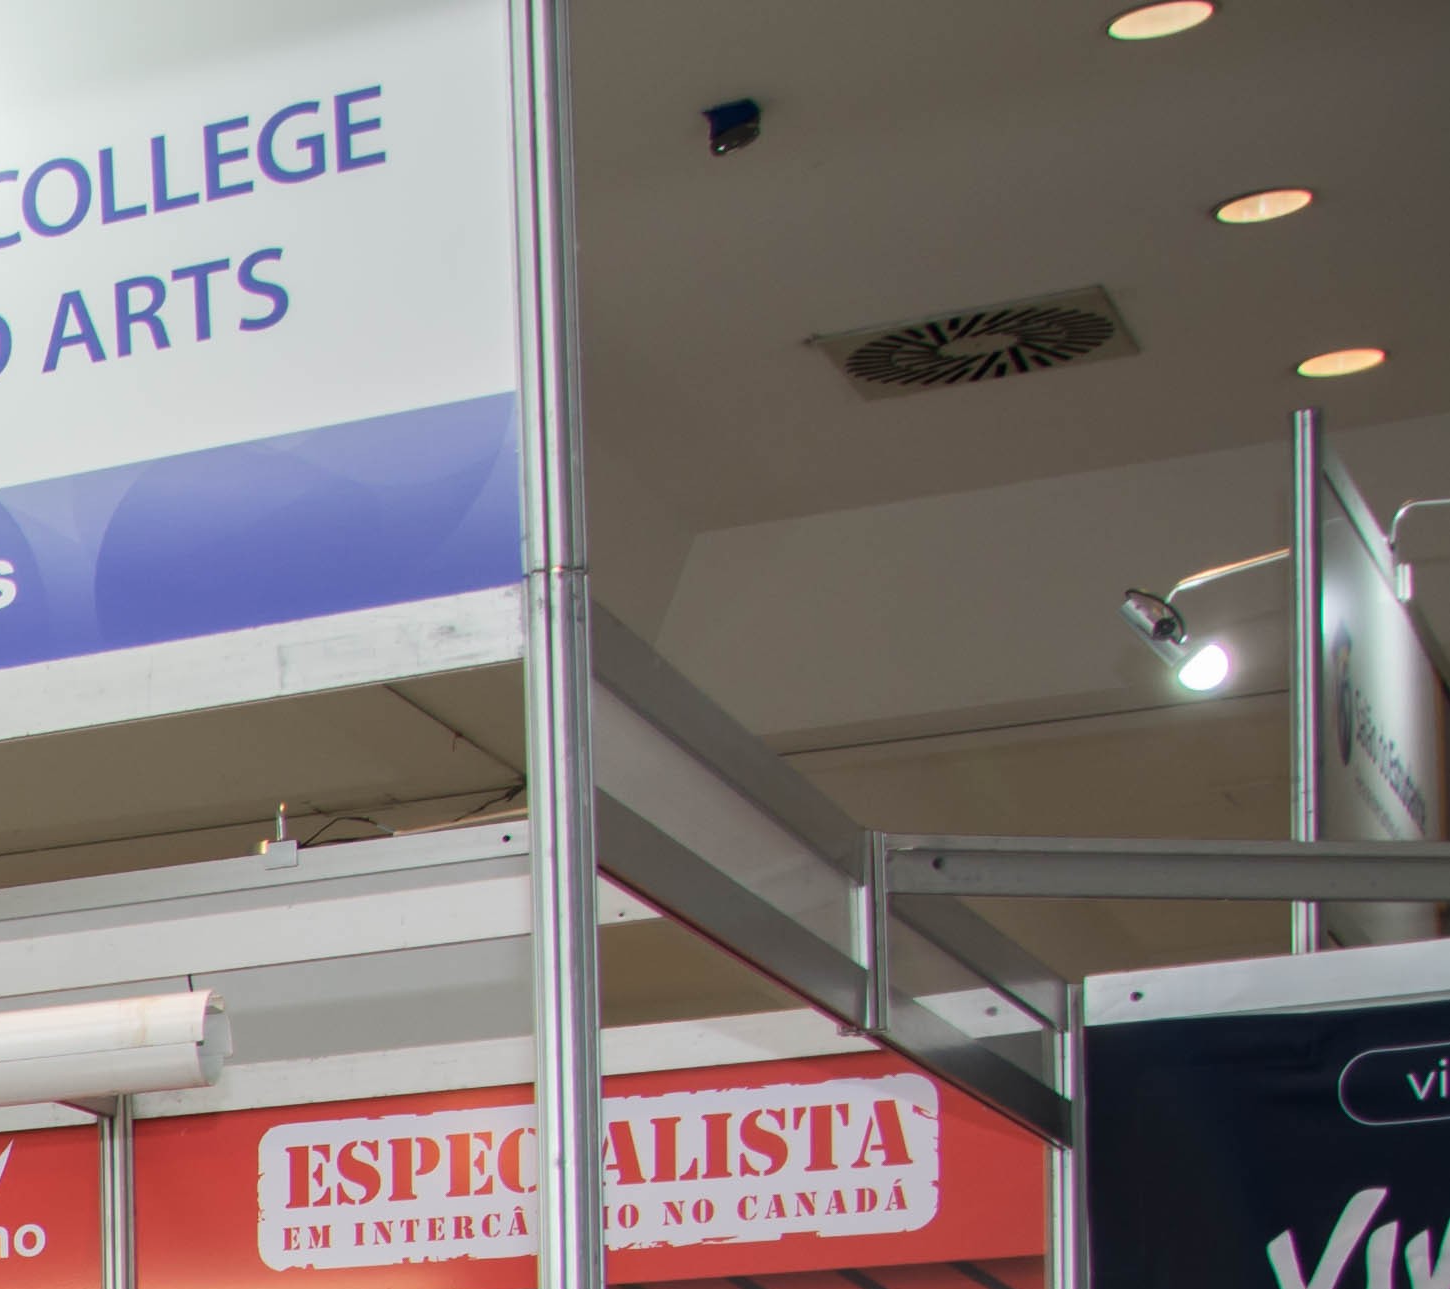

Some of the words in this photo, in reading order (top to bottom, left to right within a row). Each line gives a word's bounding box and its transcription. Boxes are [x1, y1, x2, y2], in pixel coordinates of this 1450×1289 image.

[41, 247, 291, 372] ARTS
[284, 1100, 913, 1209] ESPECALISTA
[283, 1224, 333, 1252] EM
[663, 1197, 716, 1227] NO
[737, 1180, 909, 1222] CANADÁ
